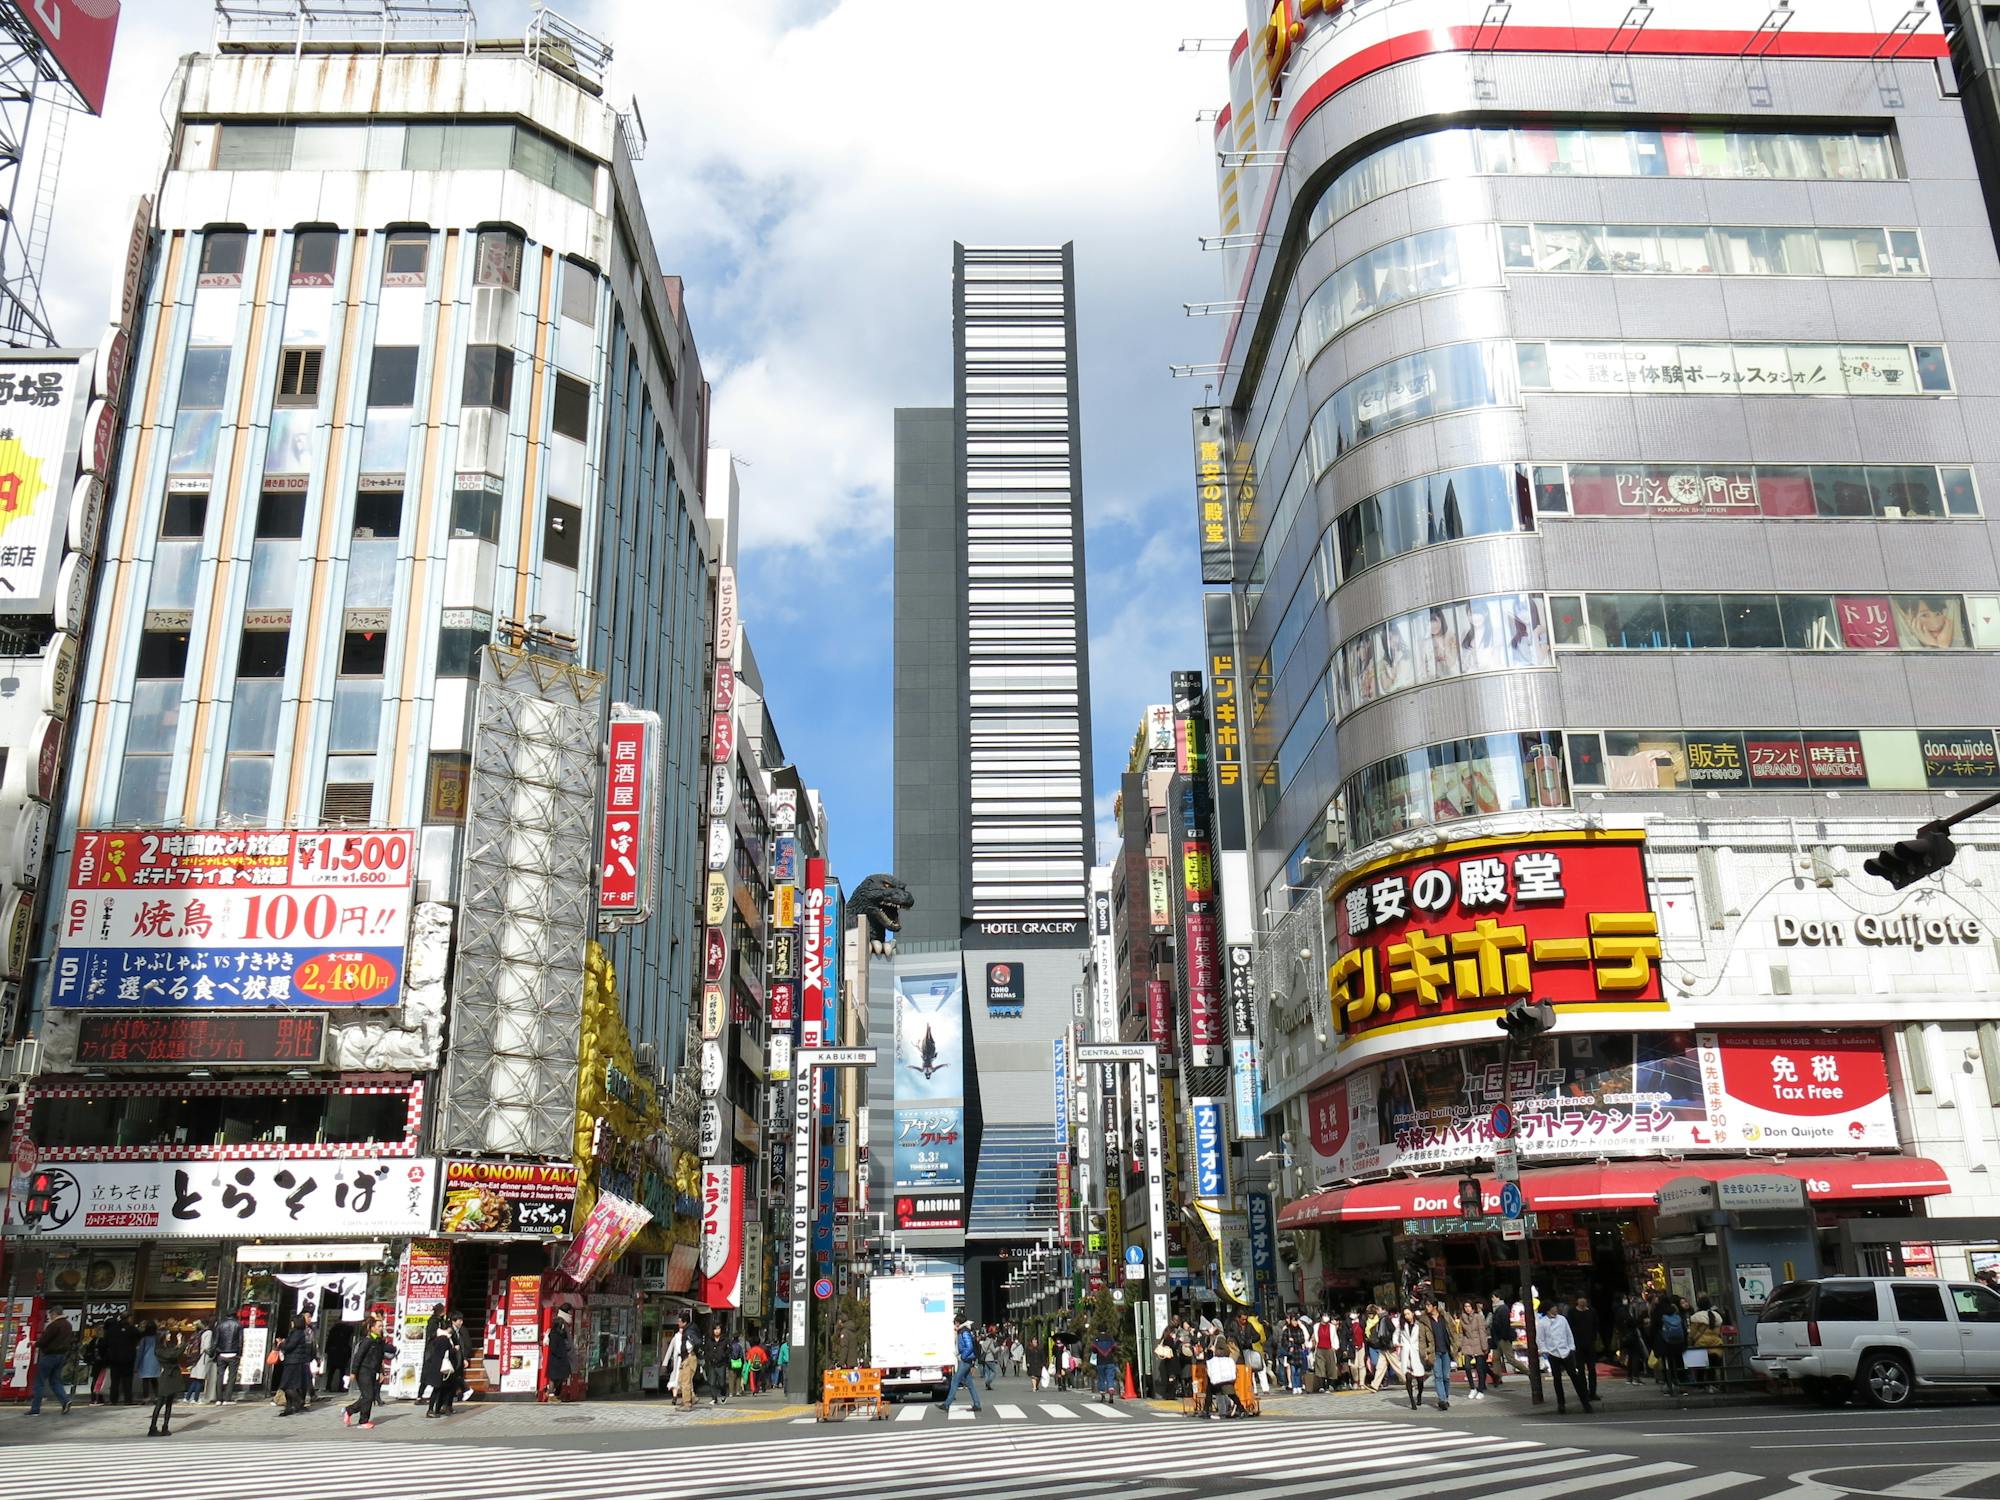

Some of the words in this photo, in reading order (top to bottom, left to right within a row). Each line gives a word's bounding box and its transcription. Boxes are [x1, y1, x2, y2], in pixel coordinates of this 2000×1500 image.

[1689, 743, 1741, 769] 販売
[1749, 746, 1799, 765] ブランド
[1809, 745, 1860, 764] 時計
[612, 740, 637, 806] 居酒屋
[1752, 763, 1801, 777] BRAND
[1811, 762, 1863, 777] WATCH
[603, 820, 636, 878] つぼ八
[132, 866, 290, 886] ポテトフライ食べ放題
[710, 885, 725, 913] 虎の子
[1346, 852, 1566, 937] 驚安の殿堂
[1192, 902, 1208, 913] 6F
[129, 898, 214, 940] 焼鳥
[980, 923, 1021, 935] HOTEL
[1021, 922, 1078, 934] GRACERY
[804, 888, 824, 991] SHIDAX
[1774, 913, 1847, 947] Don
[1855, 911, 1982, 953] Quijote
[117, 974, 293, 1002] 選べる食べ放題
[1081, 1048, 1120, 1057] CENTRAL
[1122, 1048, 1145, 1056] ROAD
[1770, 1055, 1840, 1083] 免税
[1773, 1083, 1805, 1100] Tax
[1808, 1083, 1844, 1100] Free
[1453, 1104, 1468, 1116] for
[1527, 1095, 1596, 1109] experience
[795, 1083, 809, 1193] GODZILLA
[898, 1116, 958, 1141] アサシン
[1764, 1126, 1788, 1138] Don
[1790, 1125, 1835, 1139] Quijote
[1198, 1107, 1221, 1192] カラオケ
[449, 1162, 534, 1182] OKONOMI
[539, 1167, 579, 1184] YAKI
[90, 1184, 161, 1201] 立ちそば
[171, 1165, 390, 1221] とらそば
[1721, 1183, 1798, 1196] 安全安心ステーション
[91, 1203, 122, 1212] TORA
[126, 1203, 157, 1212] SOBA
[916, 1198, 961, 1212] MARUHAN
[1413, 1196, 1448, 1212] Don
[793, 1206, 807, 1259] ROAD
[1249, 1197, 1270, 1267] カラオケ
